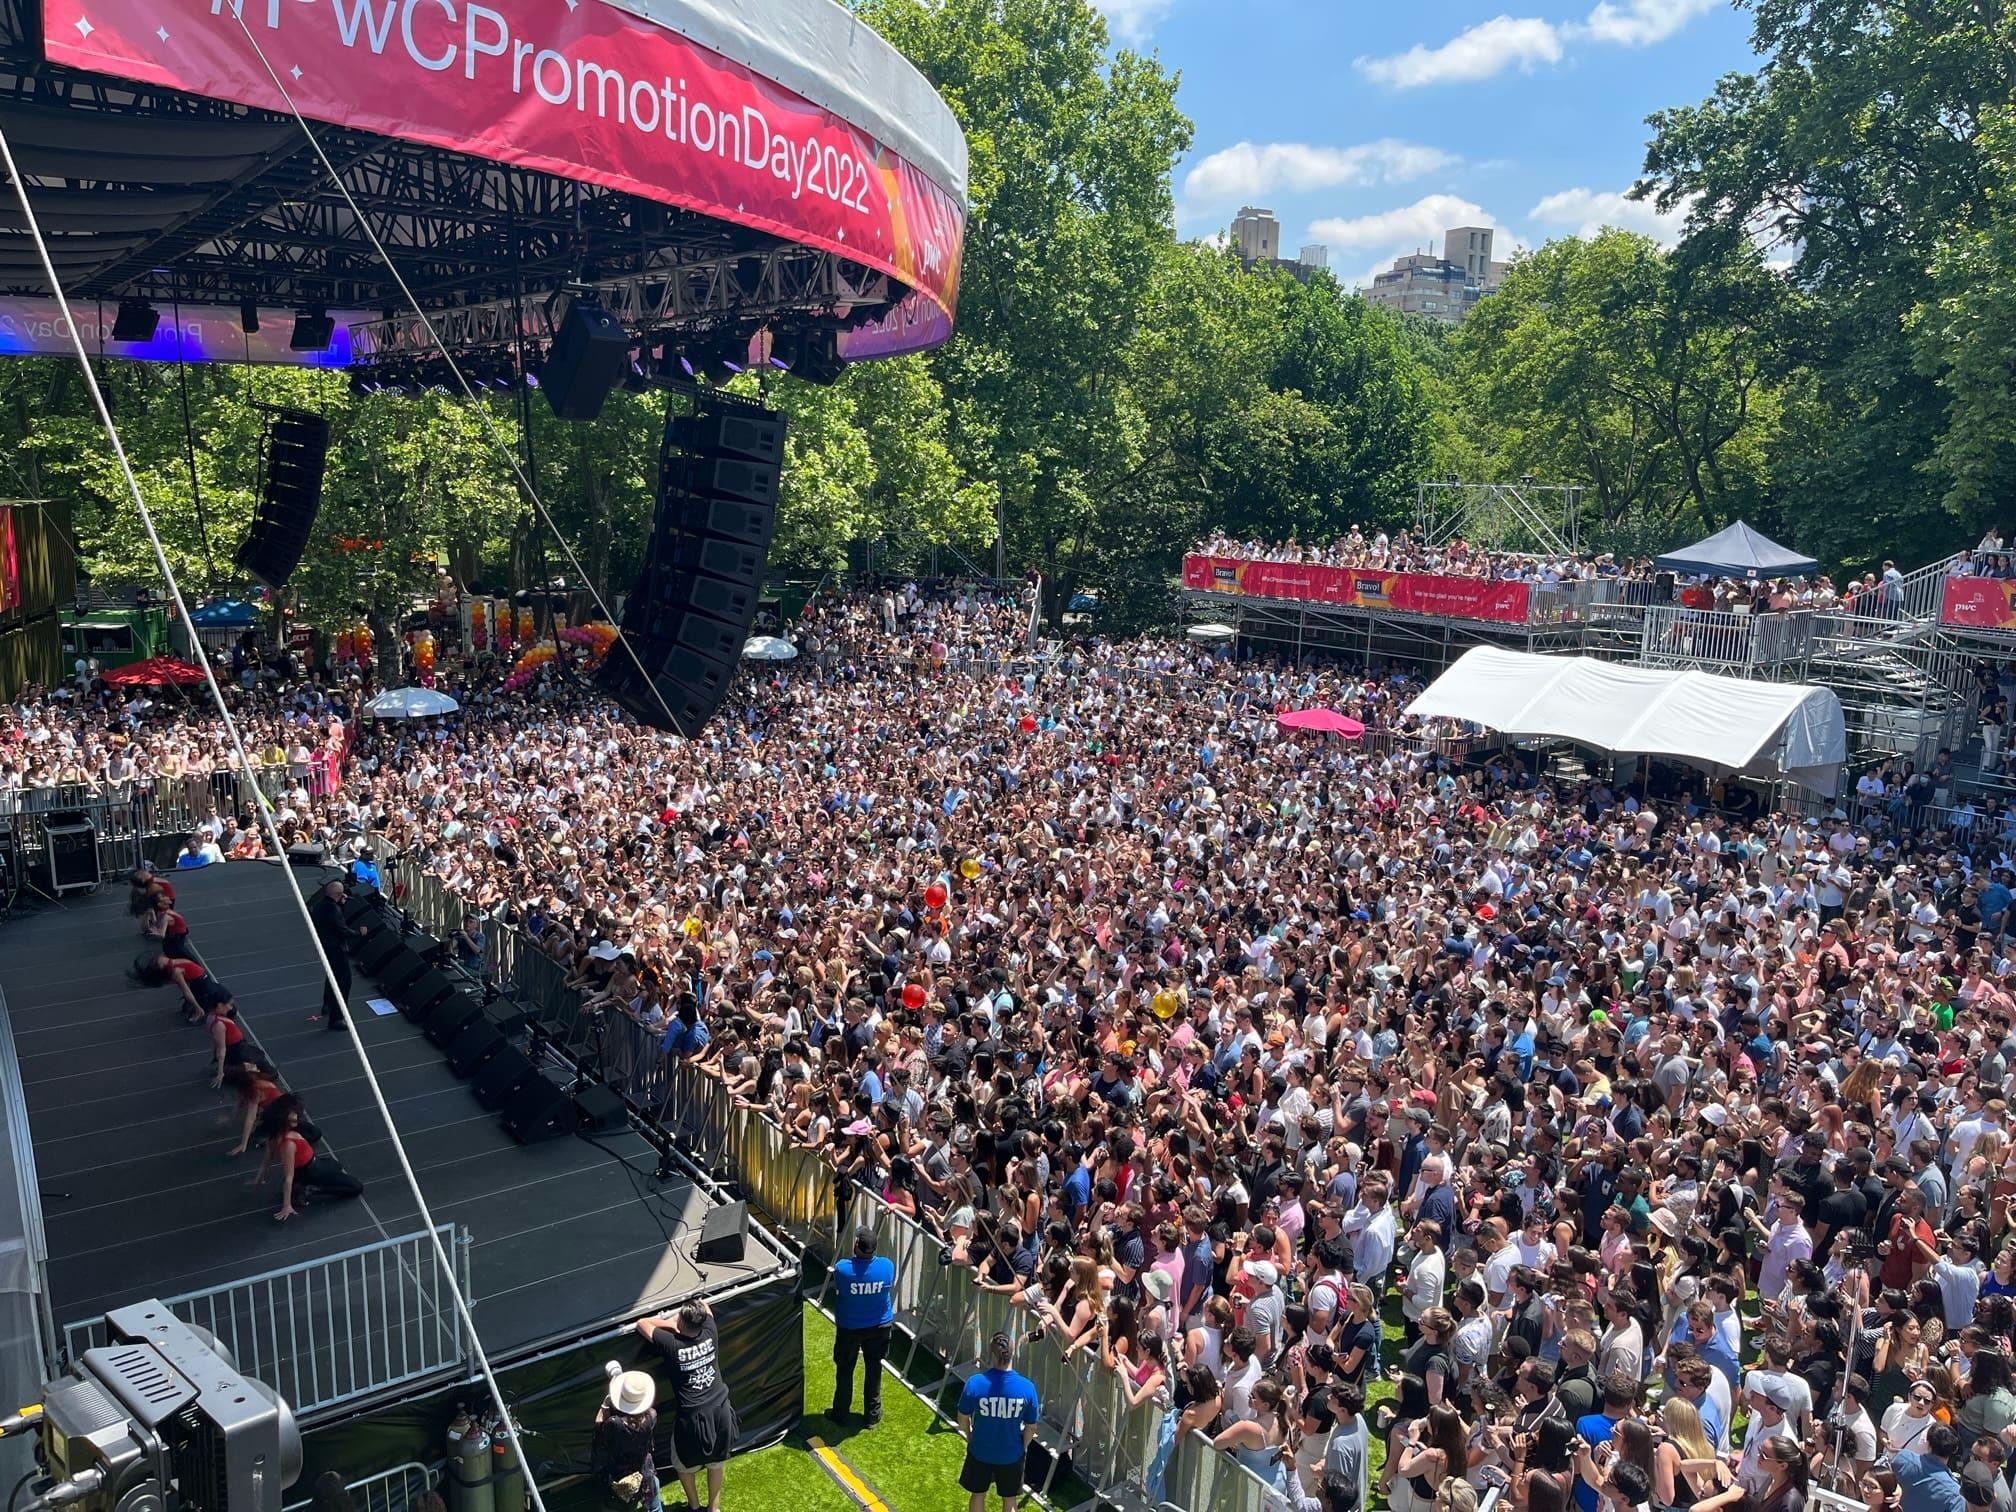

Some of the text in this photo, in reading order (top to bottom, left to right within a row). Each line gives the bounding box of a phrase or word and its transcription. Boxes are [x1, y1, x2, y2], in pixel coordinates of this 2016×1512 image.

[210, 0, 870, 215] wCPromotionDay2022
[1215, 568, 1235, 578] Bravo!
[1356, 581, 1380, 591] Bravo!
[1955, 603, 1976, 612] pwc
[849, 1281, 885, 1295] STAFF
[678, 1338, 715, 1362] STAGE
[979, 1396, 1025, 1419] STAFF
